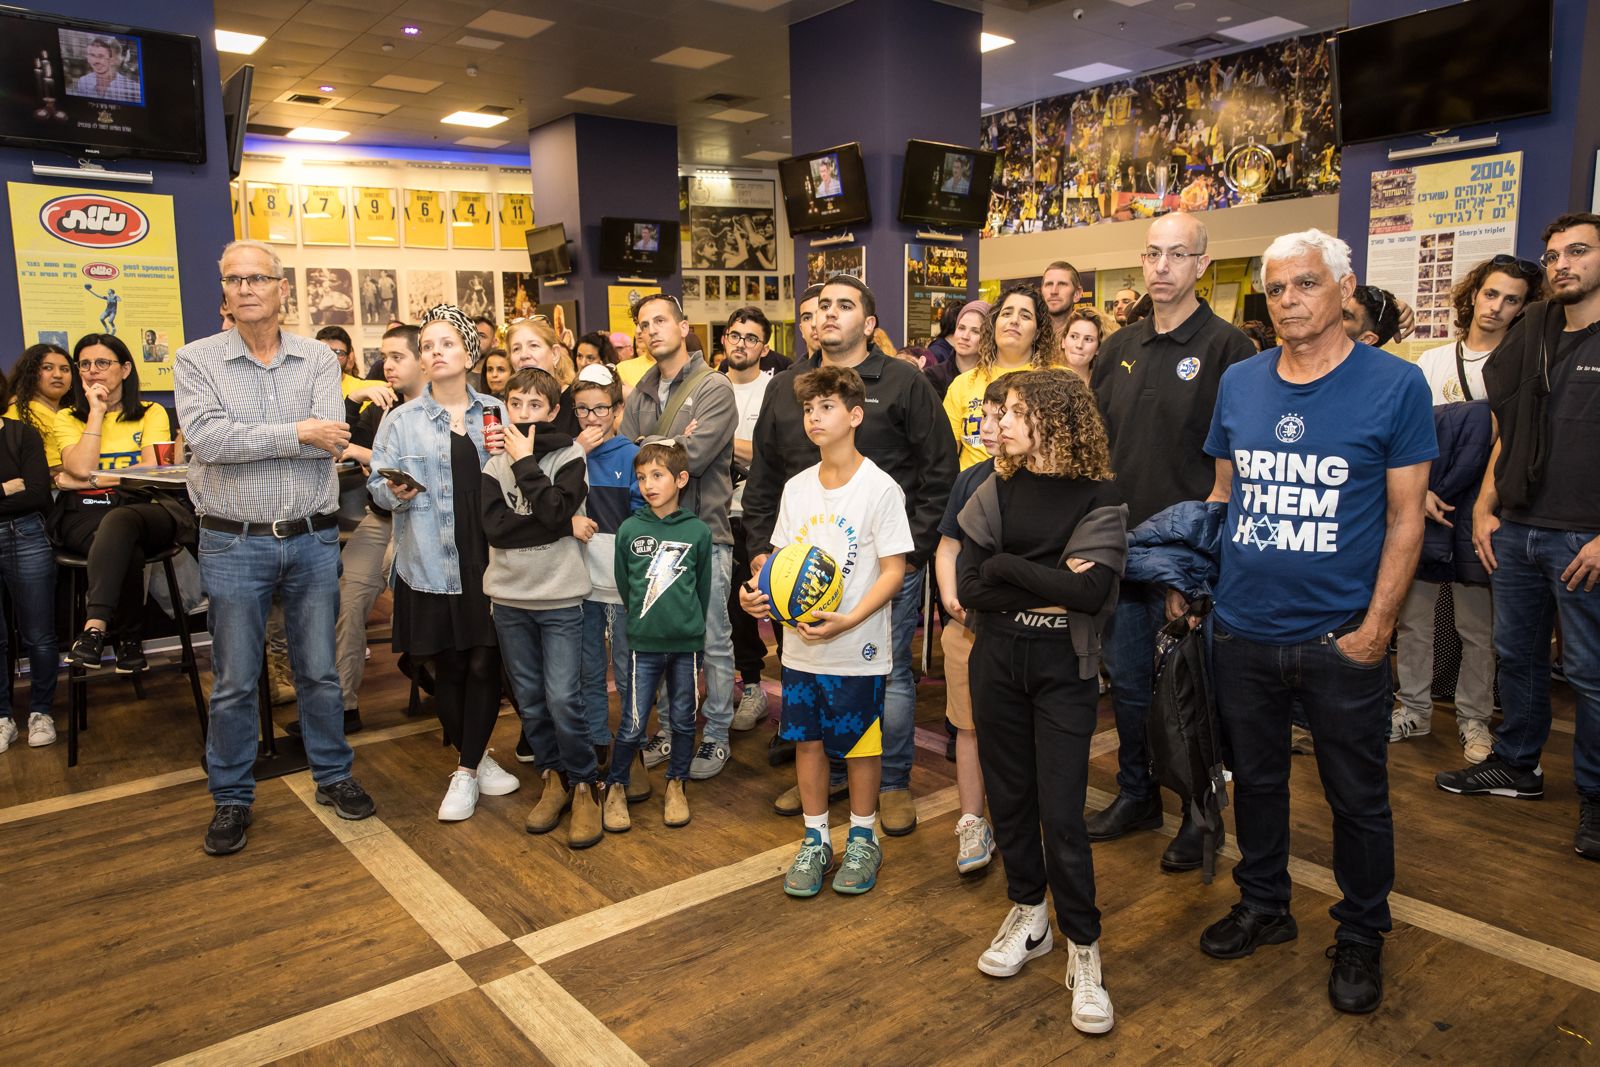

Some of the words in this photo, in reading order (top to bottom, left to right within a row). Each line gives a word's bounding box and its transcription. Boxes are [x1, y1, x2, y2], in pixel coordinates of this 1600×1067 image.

[1470, 160, 1516, 181] 2004
[1454, 182, 1493, 198] אלוהים
[1502, 179, 1517, 192] יש
[267, 195, 276, 210] 8
[319, 198, 329, 212] 7
[370, 199, 379, 214] 9
[421, 202, 429, 217] 6
[467, 203, 476, 217] 4
[60, 204, 128, 235] עלית
[512, 205, 523, 219] 11
[1458, 229, 1483, 237] Sharp's
[1484, 226, 1506, 234] triplet
[90, 265, 113, 276] elite
[1234, 449, 1349, 486] BRING
[1241, 483, 1340, 518] THEM
[810, 513, 824, 526] WE
[1014, 612, 1068, 628] NIKE
